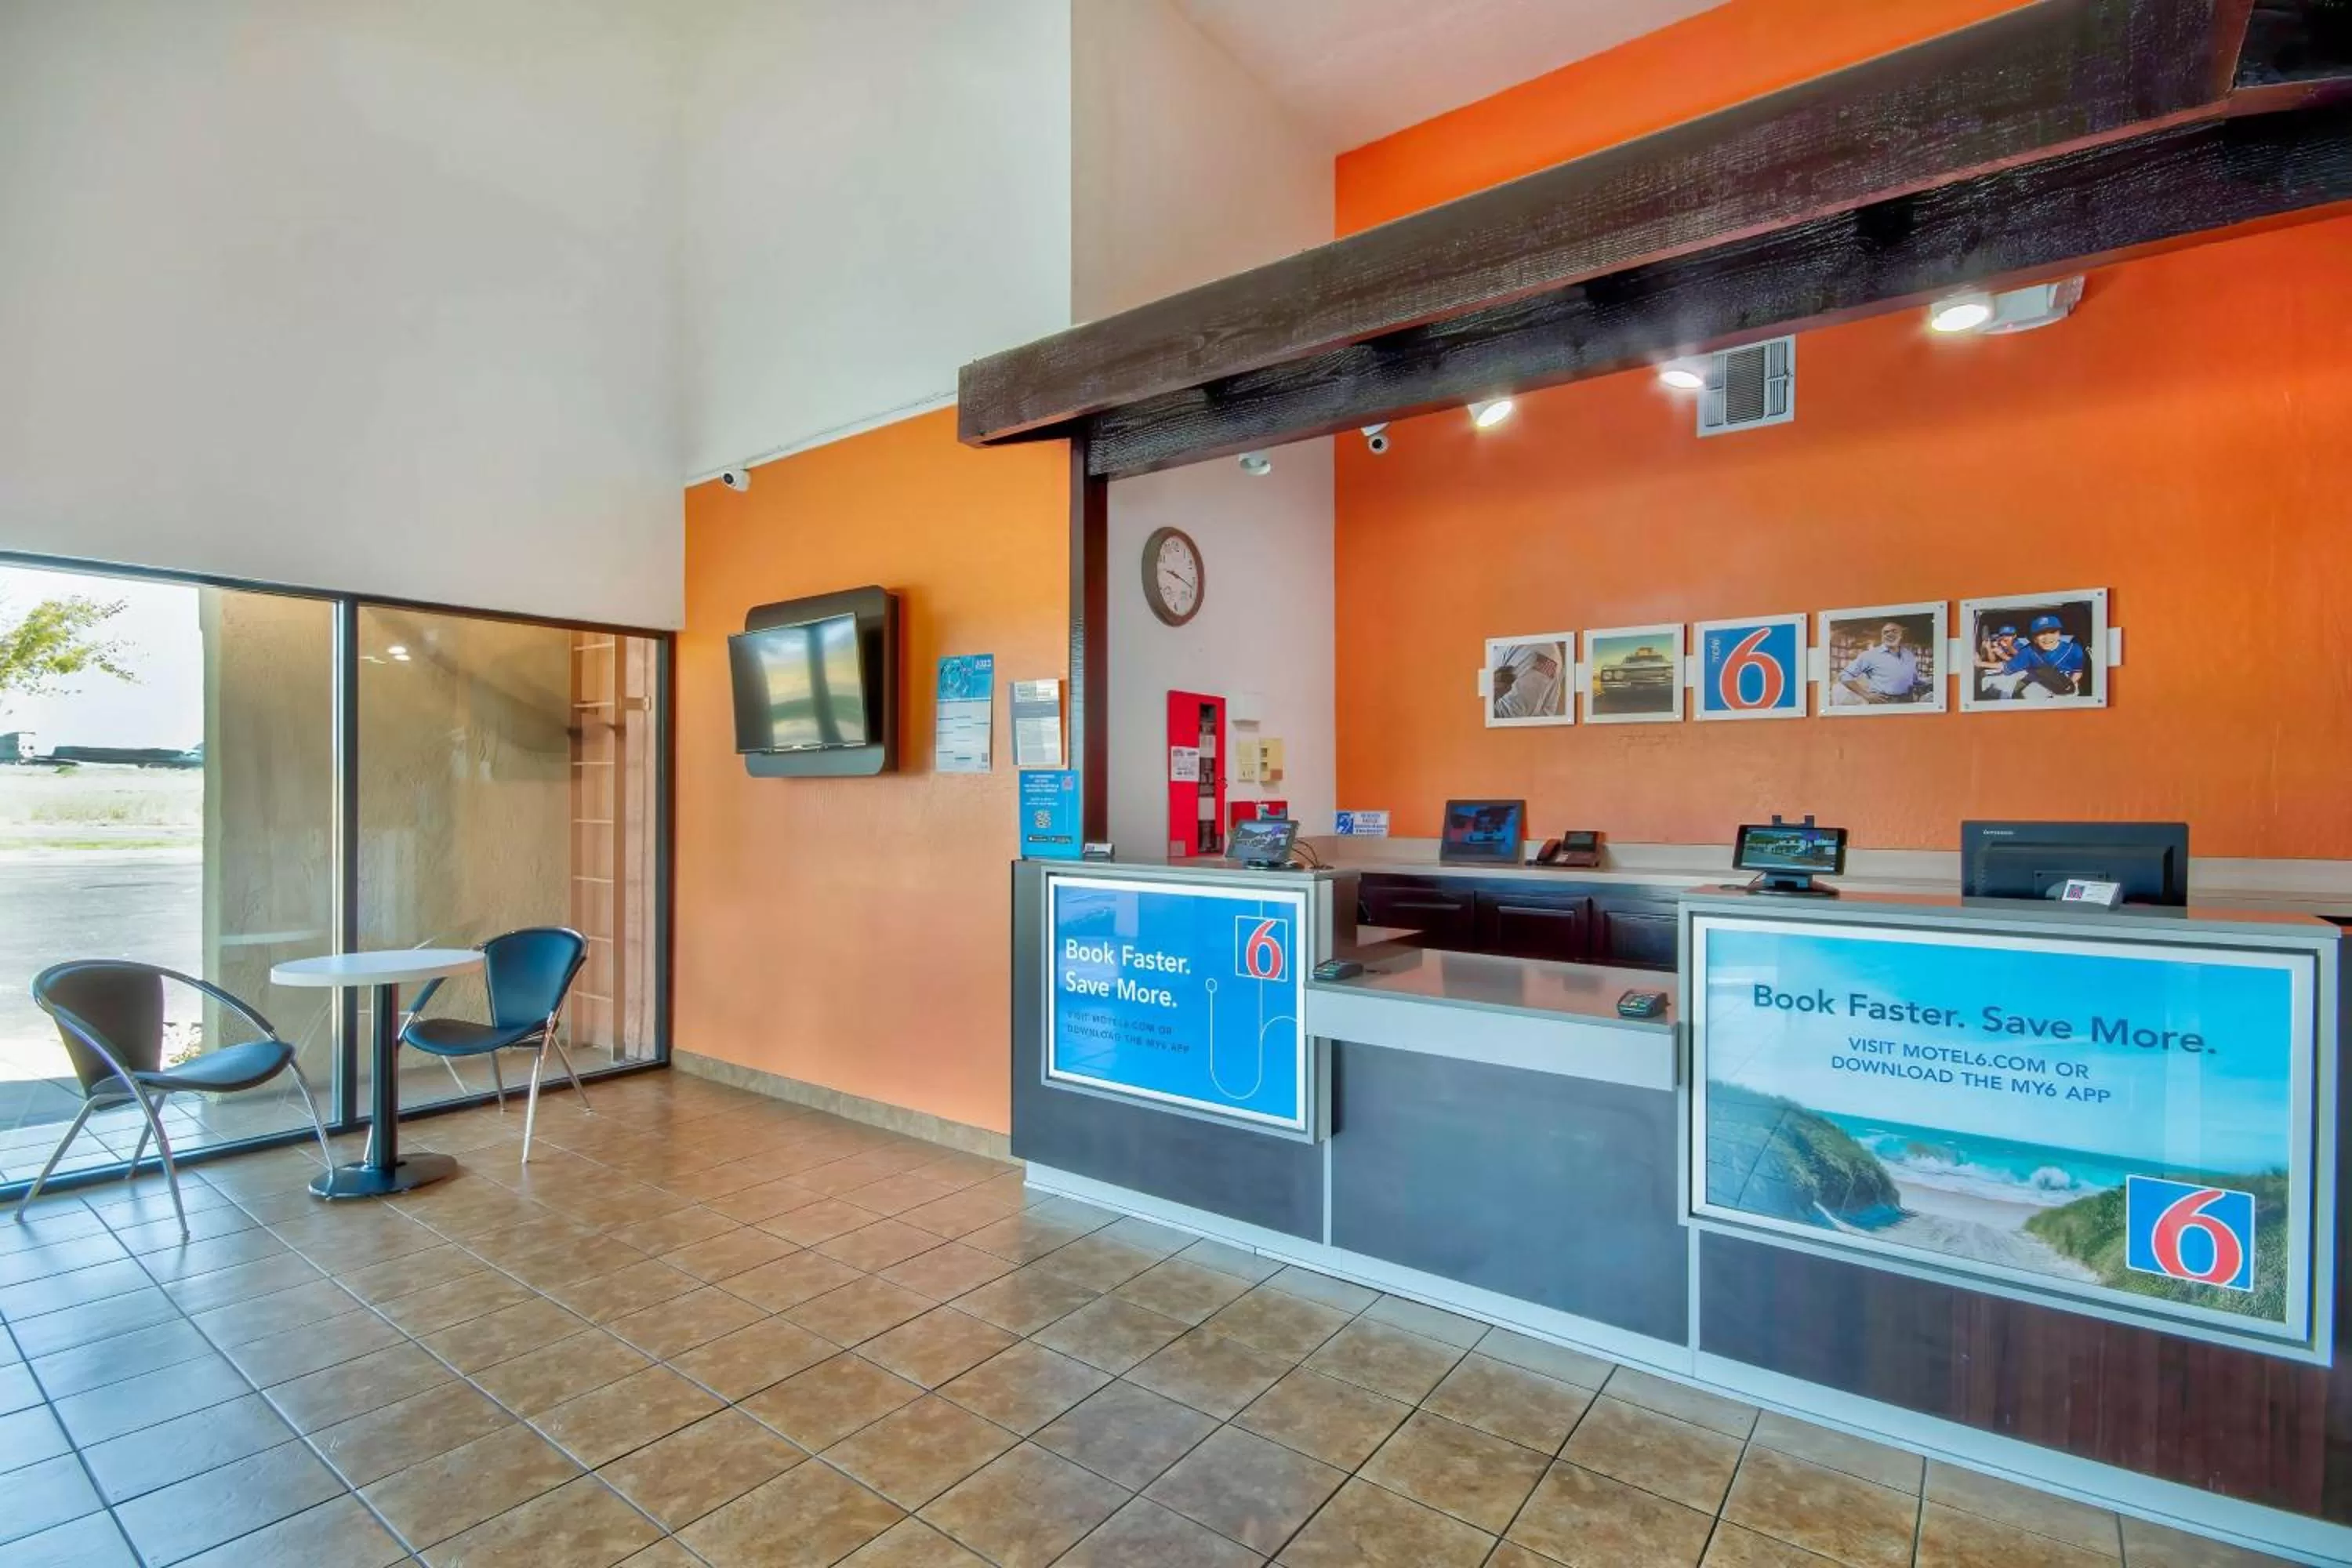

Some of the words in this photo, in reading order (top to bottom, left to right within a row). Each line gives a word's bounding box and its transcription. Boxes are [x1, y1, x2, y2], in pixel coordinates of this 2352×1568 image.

[1719, 626, 1784, 710] 6
[1065, 938, 1115, 965] Book
[1122, 944, 1191, 975] Faster.
[1245, 919, 1283, 979] 6
[1065, 971, 1109, 997] Save
[1117, 978, 1178, 1007] More.
[1754, 983, 1835, 1015] Book
[1849, 993, 1965, 1029] Faster.
[1981, 1005, 2073, 1040] Save
[2090, 1015, 2216, 1054] More.
[1831, 1055, 1953, 1083] DOWNLOAD
[1960, 1071, 2002, 1091] THE
[2011, 1078, 2057, 1098] MY6
[2064, 1085, 2111, 1103] APP
[1848, 1036, 1896, 1055] VISIT
[1903, 1044, 2046, 1074] MOTEL6.COM
[2055, 1062, 2090, 1080] OR
[2151, 1188, 2243, 1287] 6
